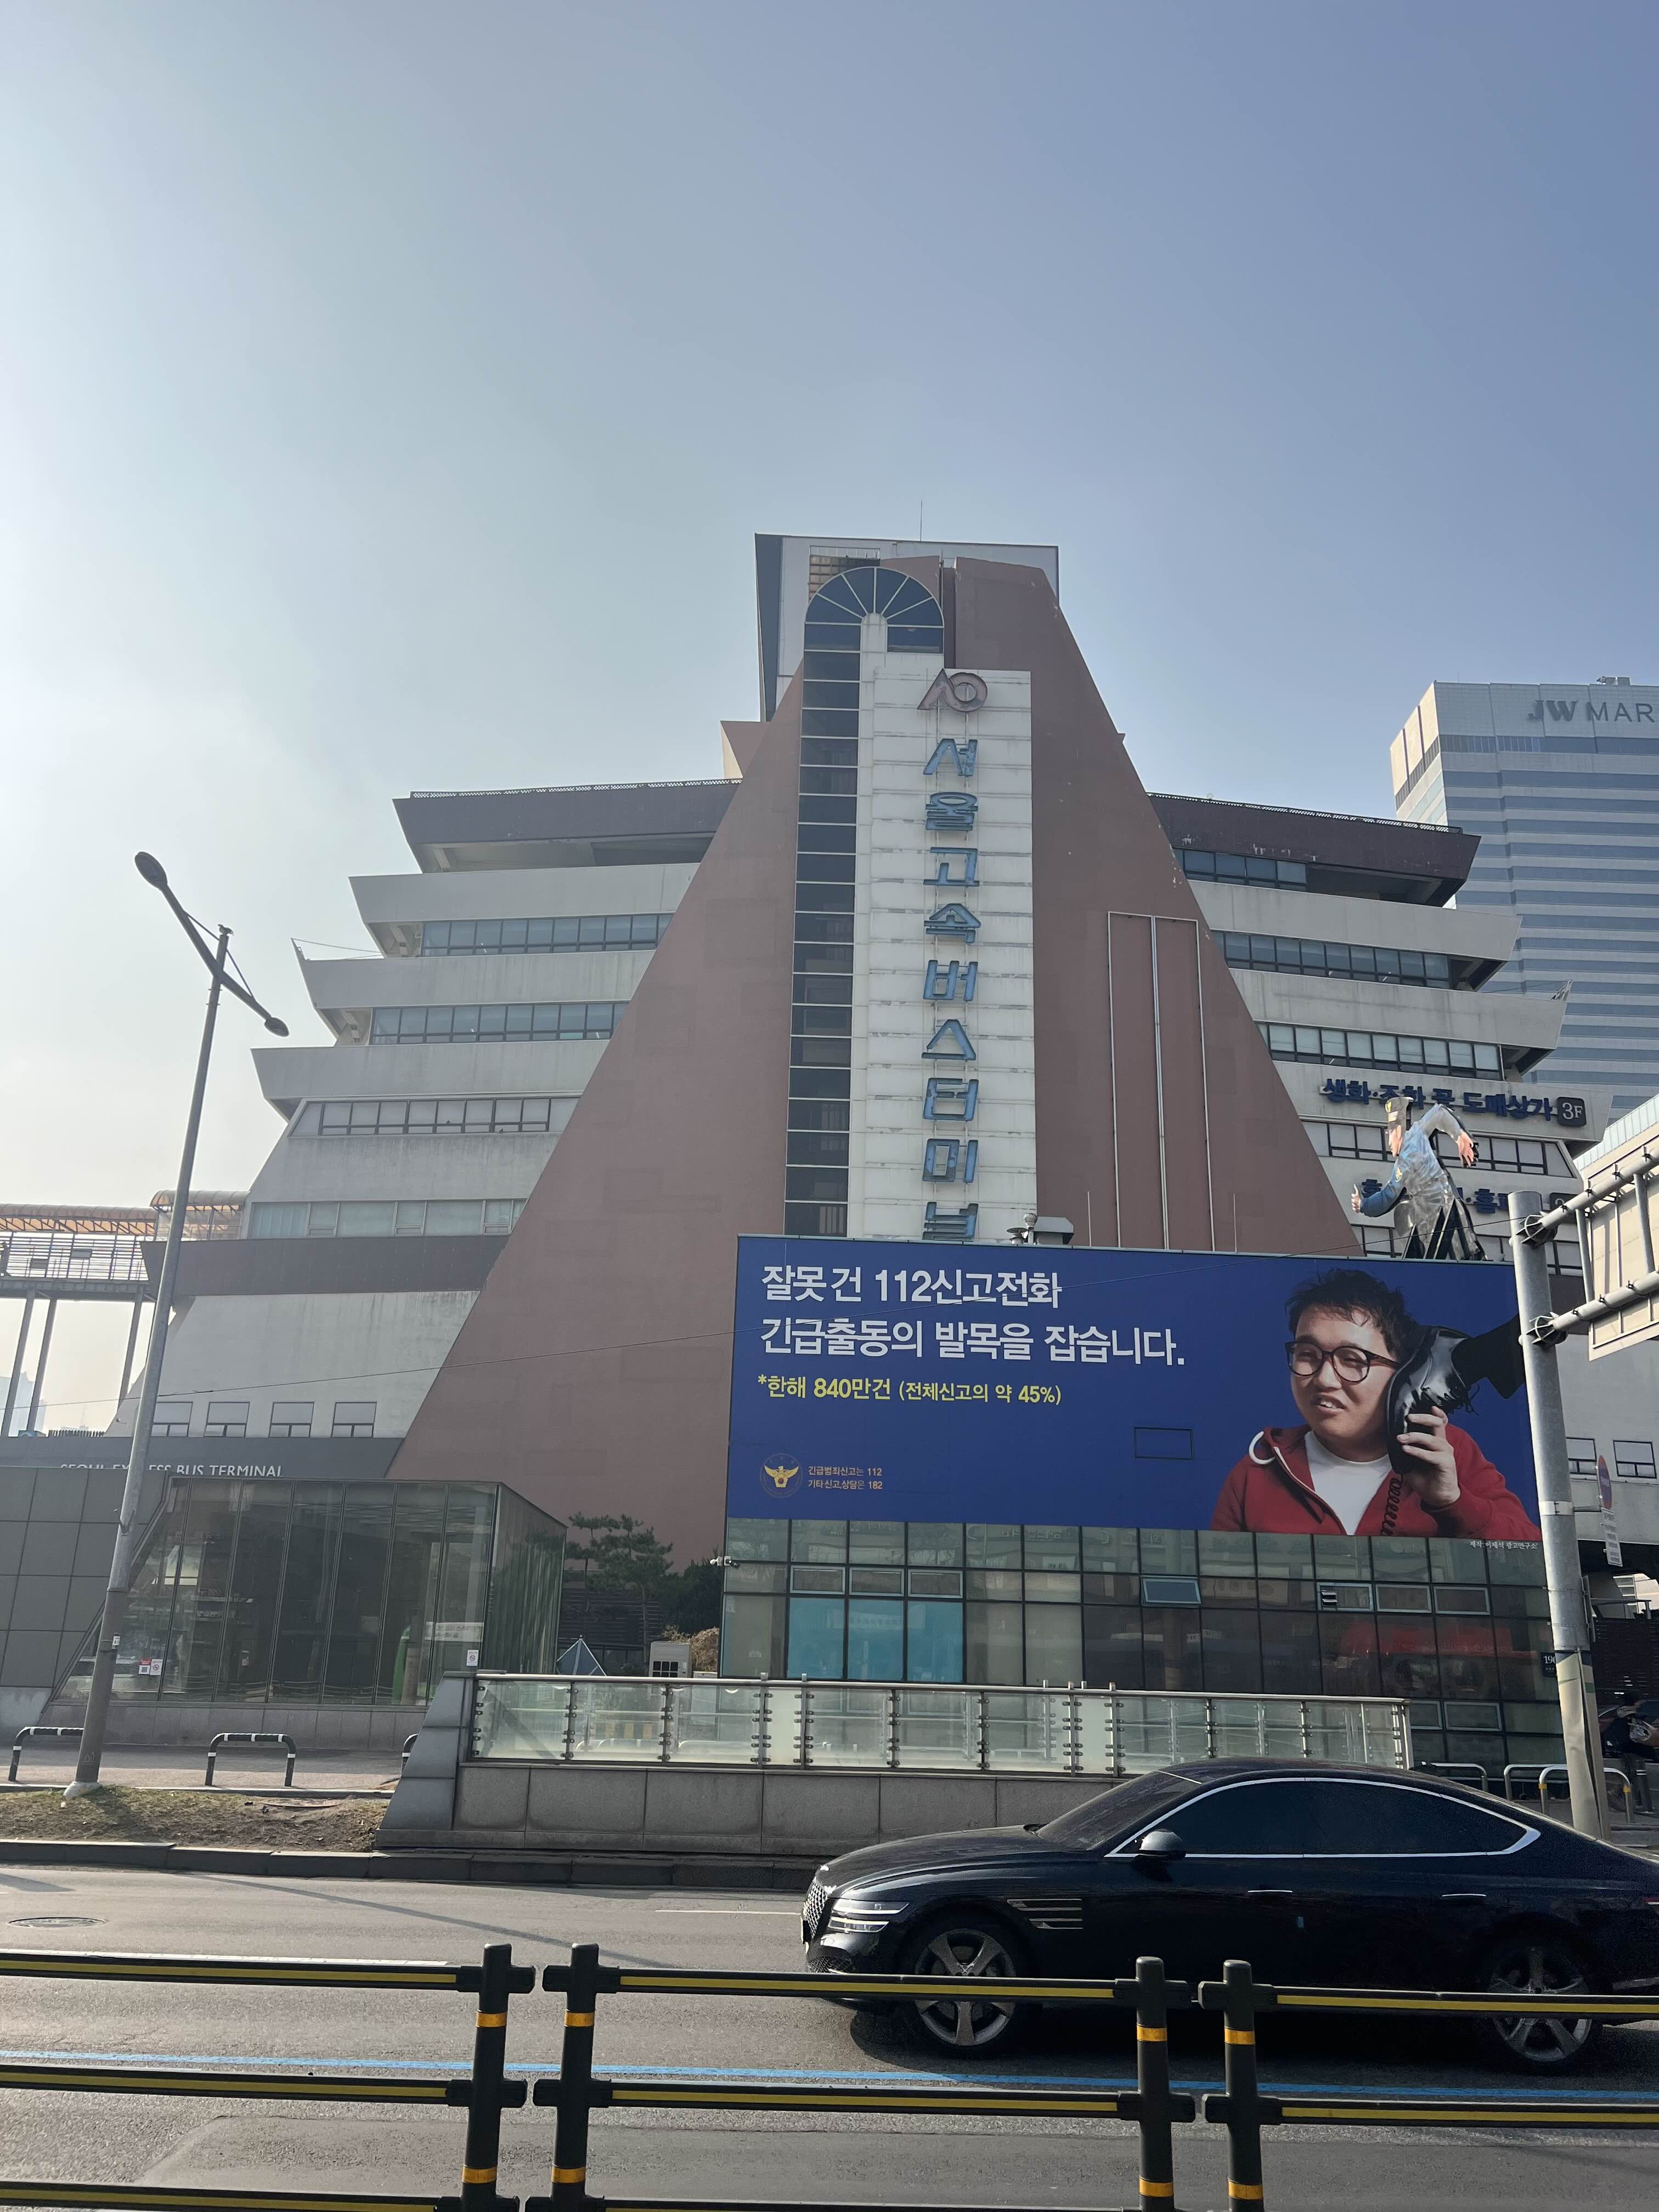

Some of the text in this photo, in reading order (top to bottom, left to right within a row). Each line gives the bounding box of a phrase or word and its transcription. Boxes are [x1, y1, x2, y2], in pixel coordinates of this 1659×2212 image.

[1528, 699, 1655, 723] JW MAR
[1562, 1102, 1583, 1120] 3F
[875, 1269, 1063, 1309] 112신고전화
[760, 1317, 1185, 1366] 긴급출동의 발목을 잡습니다.
[814, 1378, 891, 1401] 840만건
[899, 1380, 989, 1403] (전체신고의
[995, 1384, 1013, 1403] 약
[1018, 1385, 1062, 1406] 45%)
[209, 1465, 282, 1477] TERMINAL
[808, 1465, 883, 1476] 긴급범죄신고는 112
[867, 1480, 883, 1490] 182
